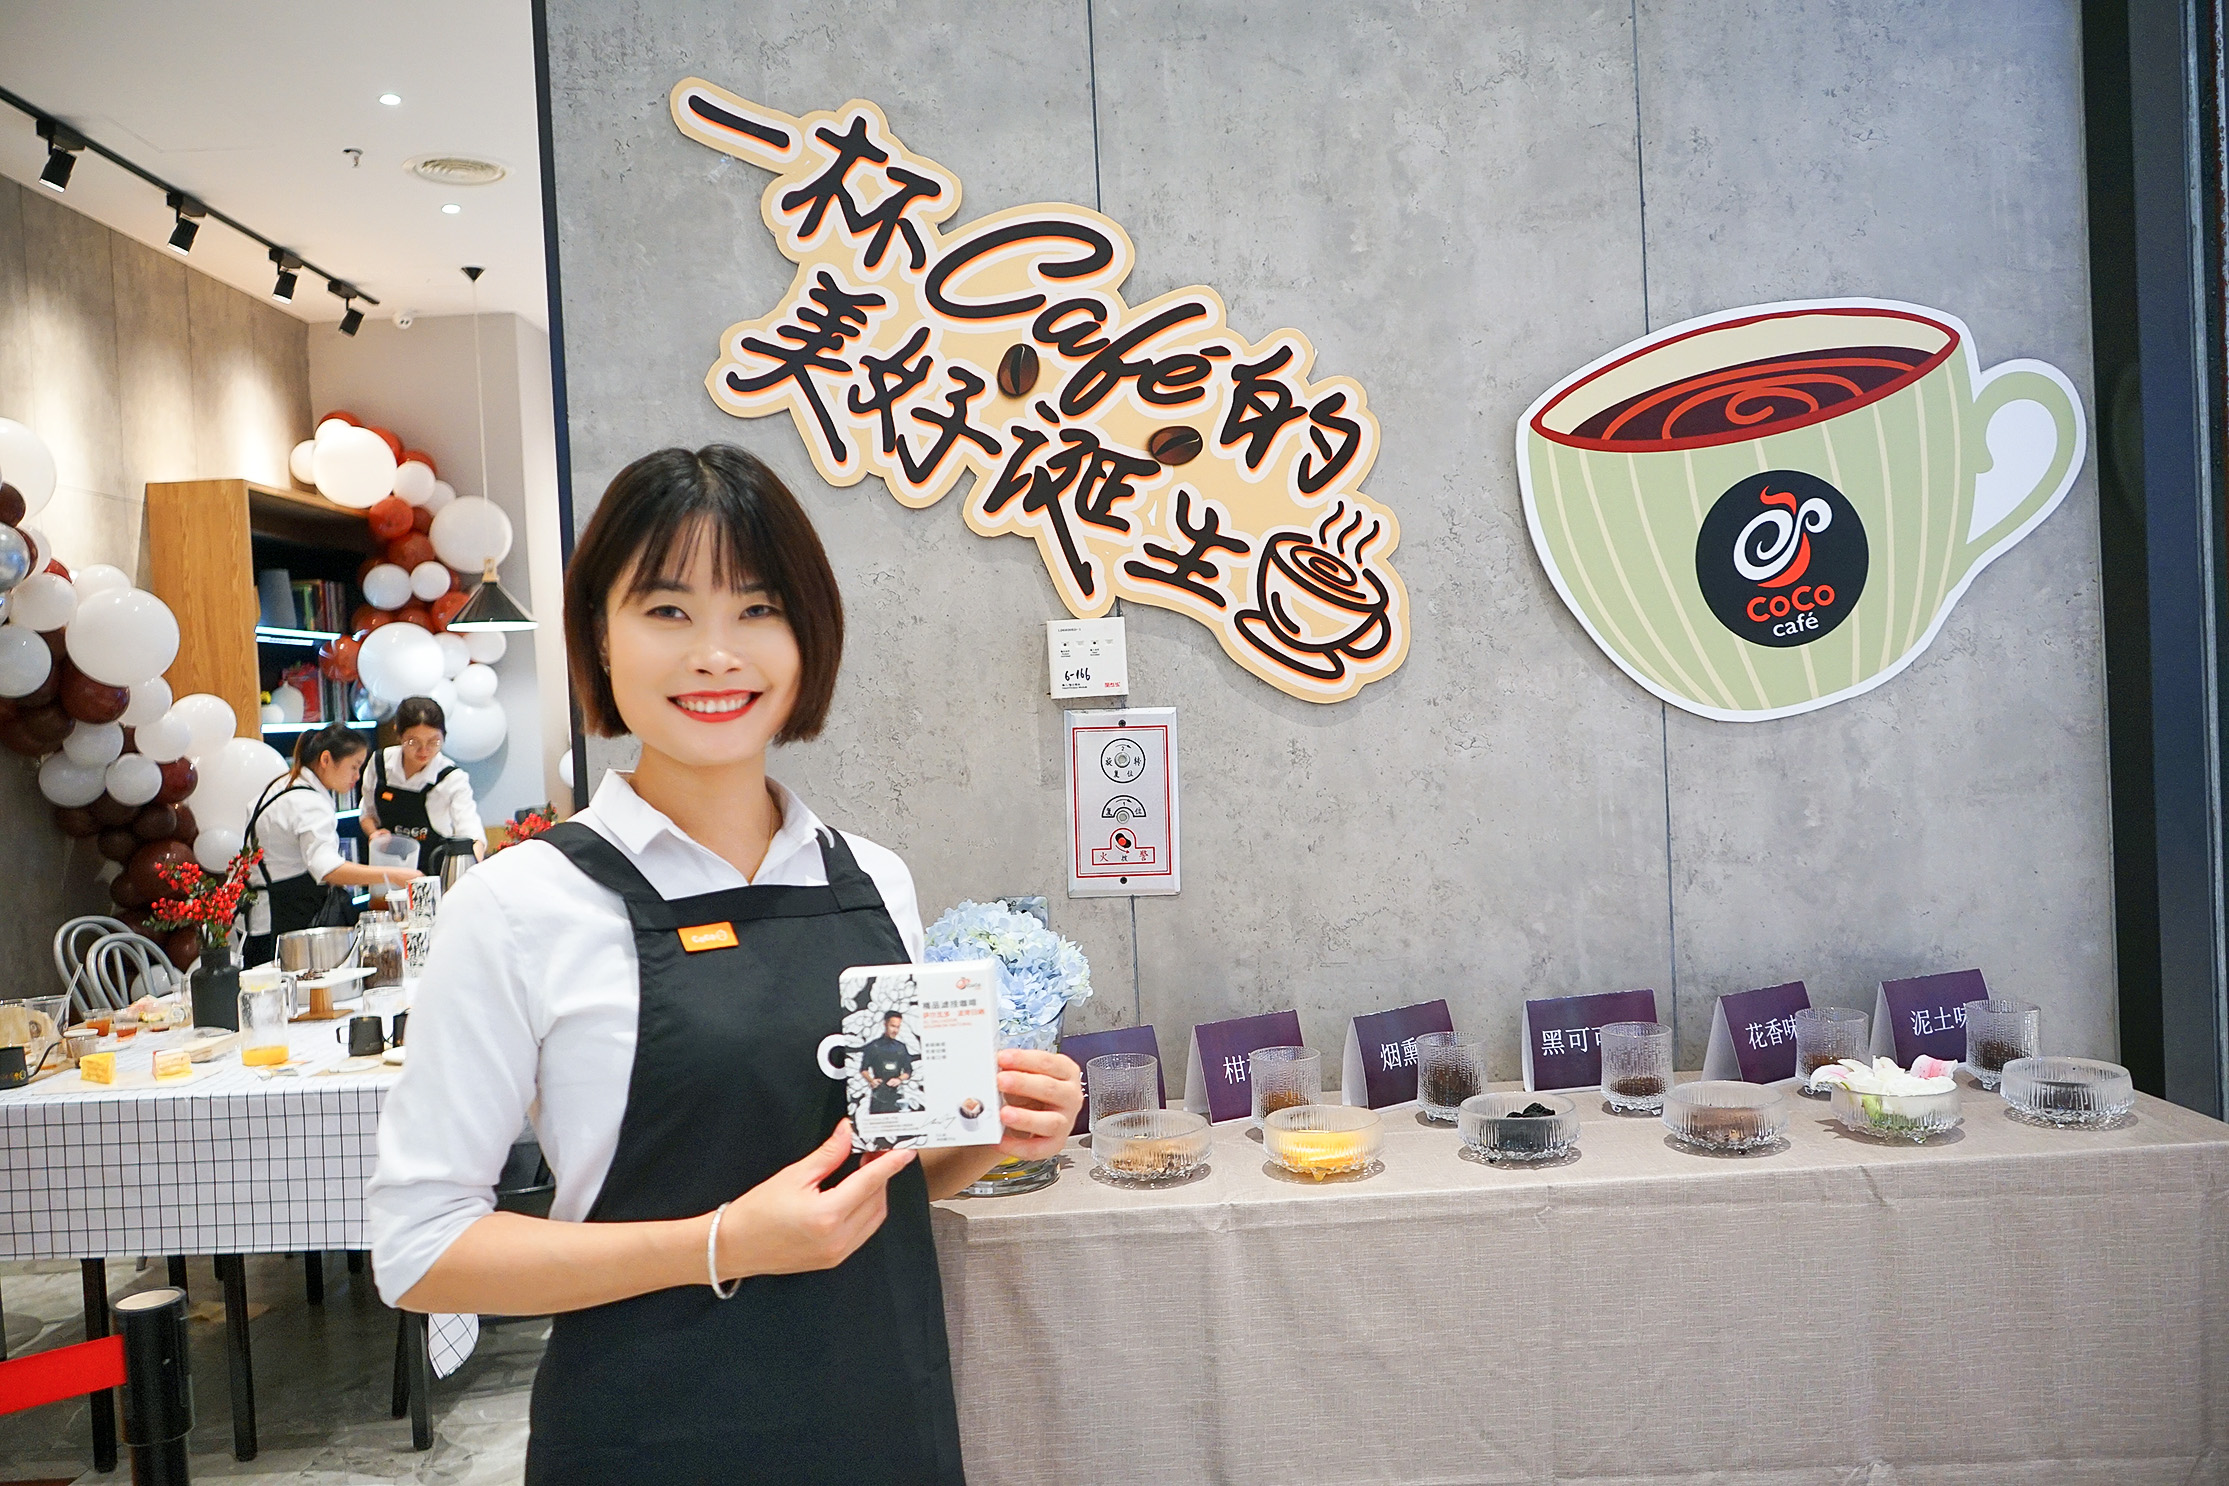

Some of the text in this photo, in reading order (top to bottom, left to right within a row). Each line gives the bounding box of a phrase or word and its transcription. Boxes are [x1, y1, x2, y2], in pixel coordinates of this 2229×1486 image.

[924, 219, 1230, 417] Café
[1772, 611, 1820, 637] café
[1064, 667, 1091, 682] 6-166
[1222, 1052, 1252, 1084] 柑
